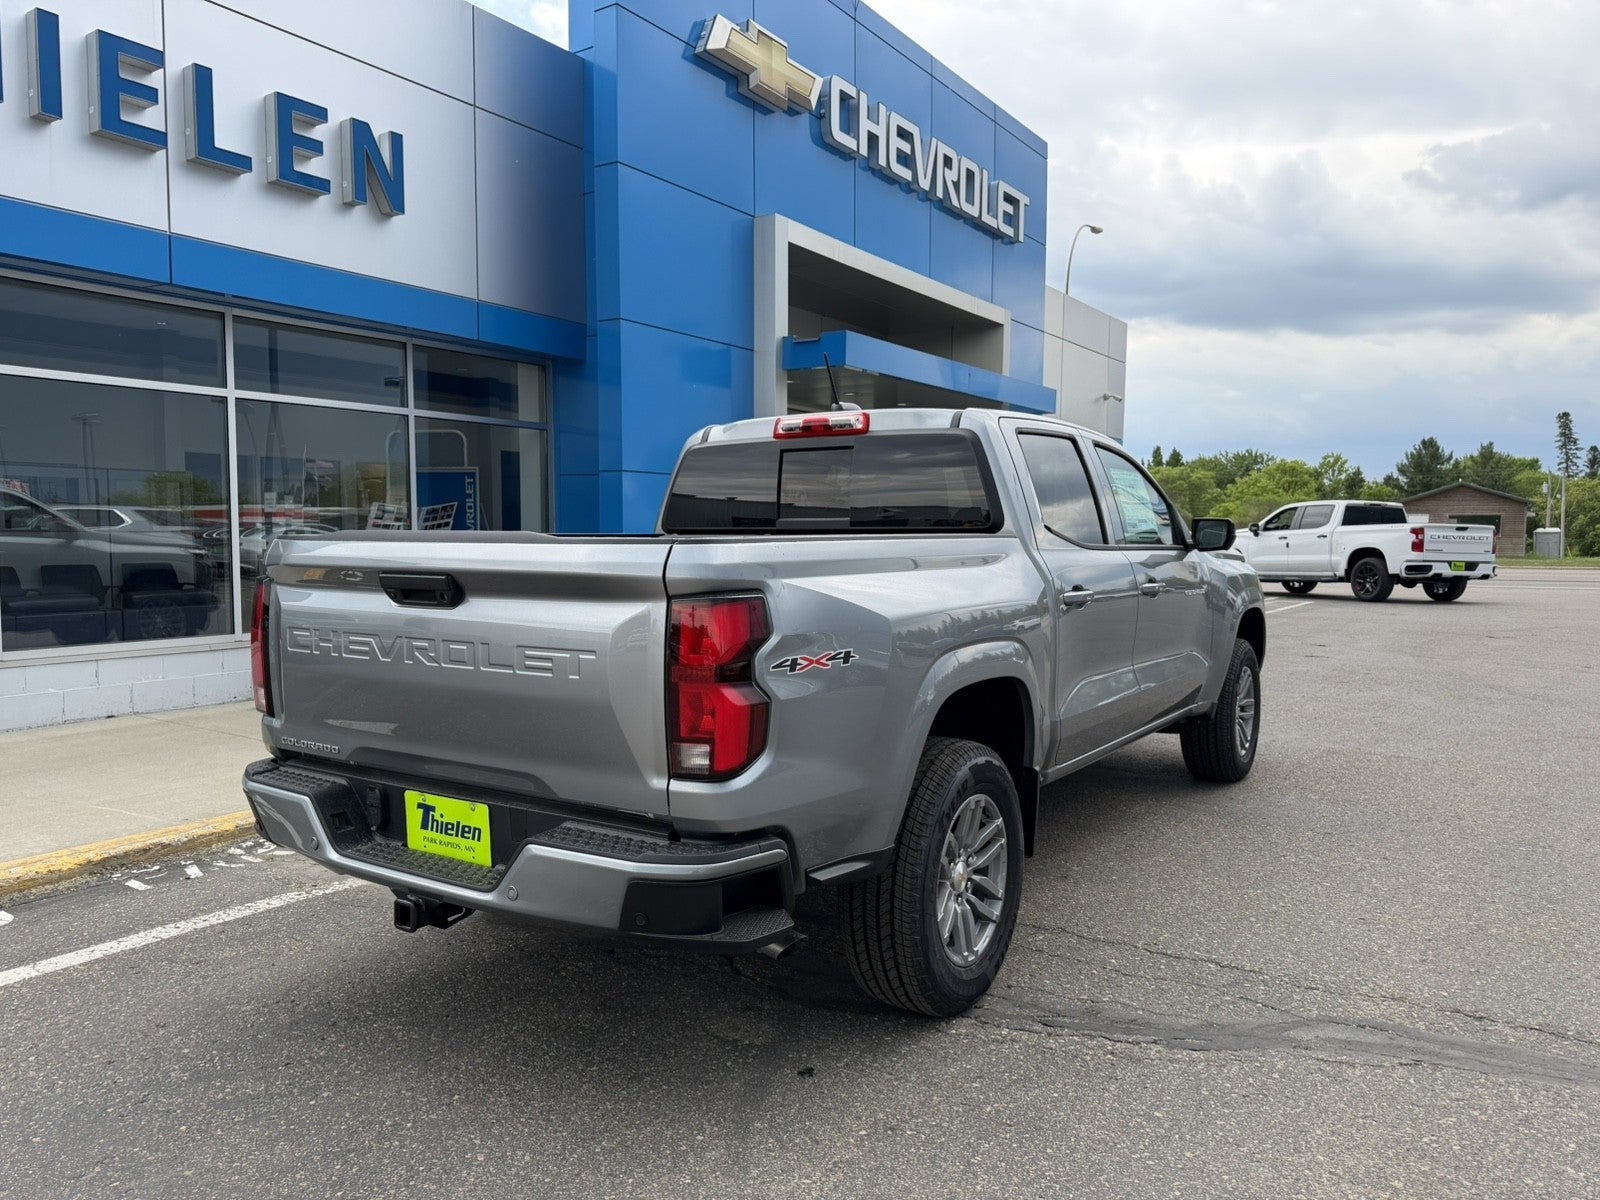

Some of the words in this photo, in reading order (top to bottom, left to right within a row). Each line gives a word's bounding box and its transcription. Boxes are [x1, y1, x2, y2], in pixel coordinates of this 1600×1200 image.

[0, 6, 405, 217] IELEN
[820, 74, 1030, 243] CHEVROLET
[286, 626, 597, 679] CHEVROLET
[281, 736, 340, 754] COLORADO
[416, 802, 482, 842] Thielen
[423, 836, 438, 845] PARK
[464, 845, 476, 853] MN
